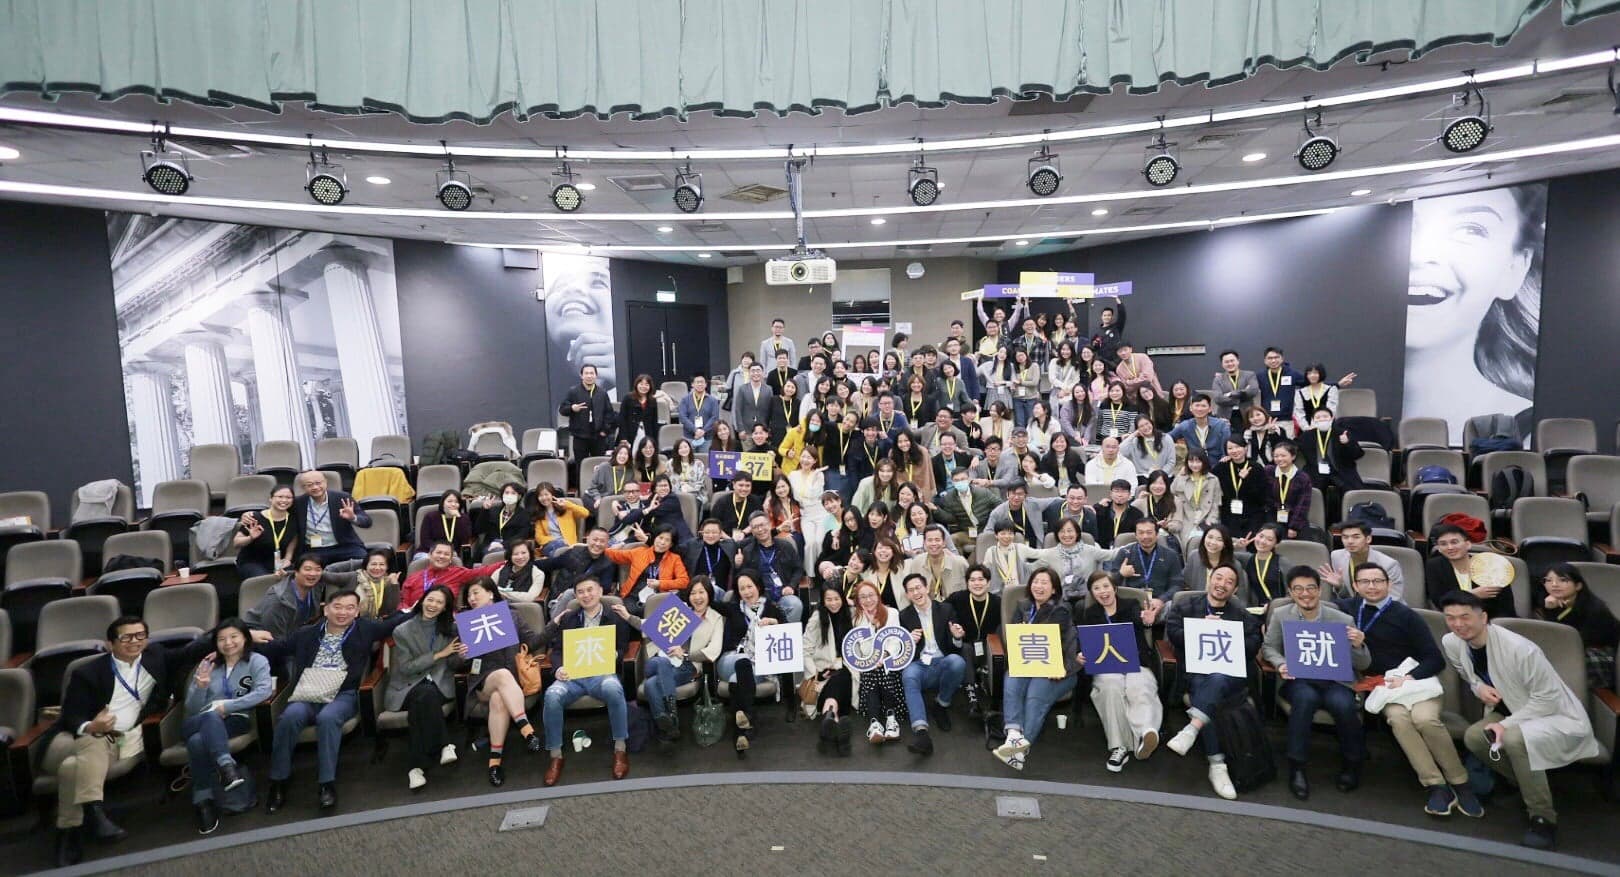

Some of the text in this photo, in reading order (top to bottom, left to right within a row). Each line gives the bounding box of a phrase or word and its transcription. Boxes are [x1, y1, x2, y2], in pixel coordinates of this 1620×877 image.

[470, 613, 506, 644] 未
[656, 606, 691, 643] 領
[575, 635, 607, 668] 來
[765, 632, 794, 663] 袖
[846, 630, 863, 657] MENTEE
[1018, 632, 1050, 664] 貴
[1094, 632, 1129, 664] 人
[1198, 629, 1233, 663] 成
[1296, 630, 1339, 667] 就
[236, 675, 253, 697] S
